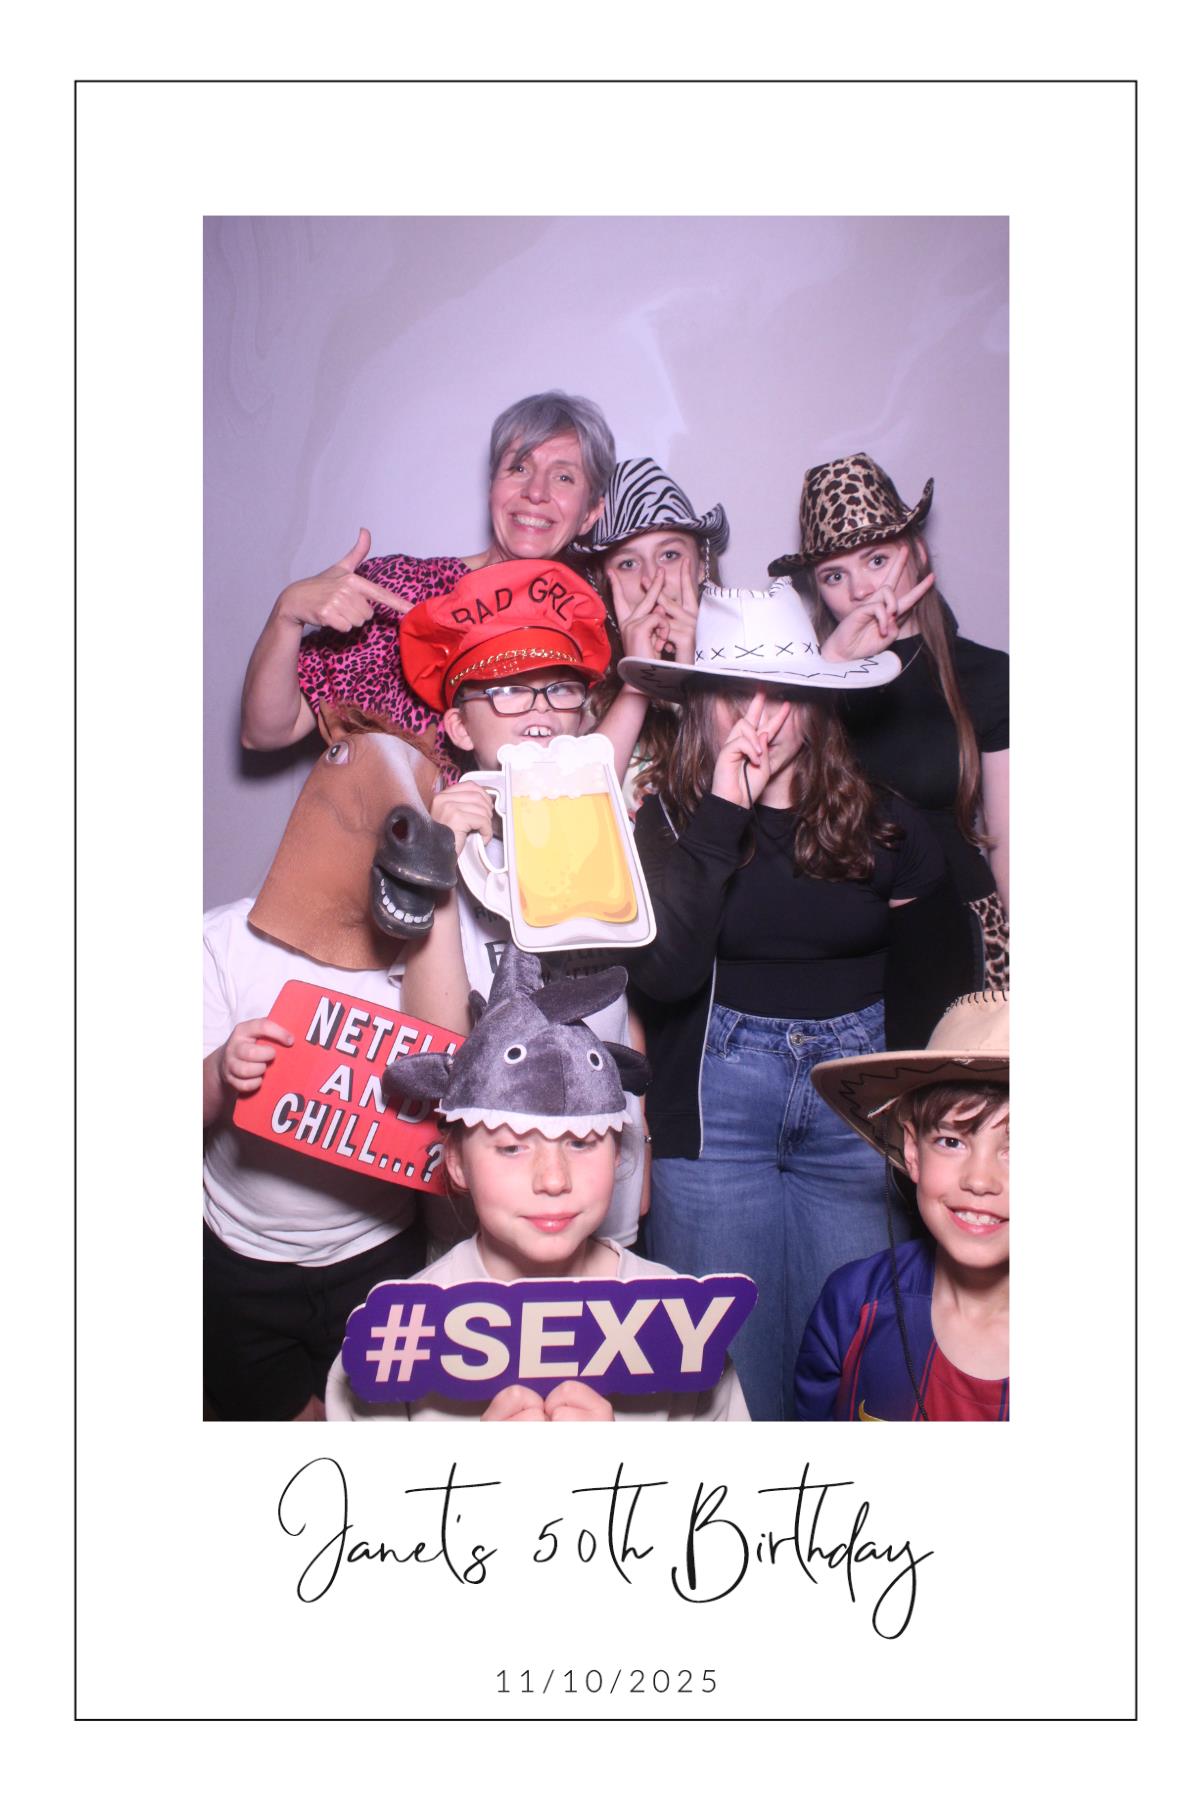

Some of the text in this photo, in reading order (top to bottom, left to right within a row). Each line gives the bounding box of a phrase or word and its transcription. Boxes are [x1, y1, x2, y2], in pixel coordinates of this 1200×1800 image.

[450, 576, 576, 625] BAD GRL
[305, 996, 458, 1067] NETF
[319, 1064, 433, 1124] AND
[271, 1092, 445, 1183] CHILL...?
[366, 1296, 736, 1383] #SEXY
